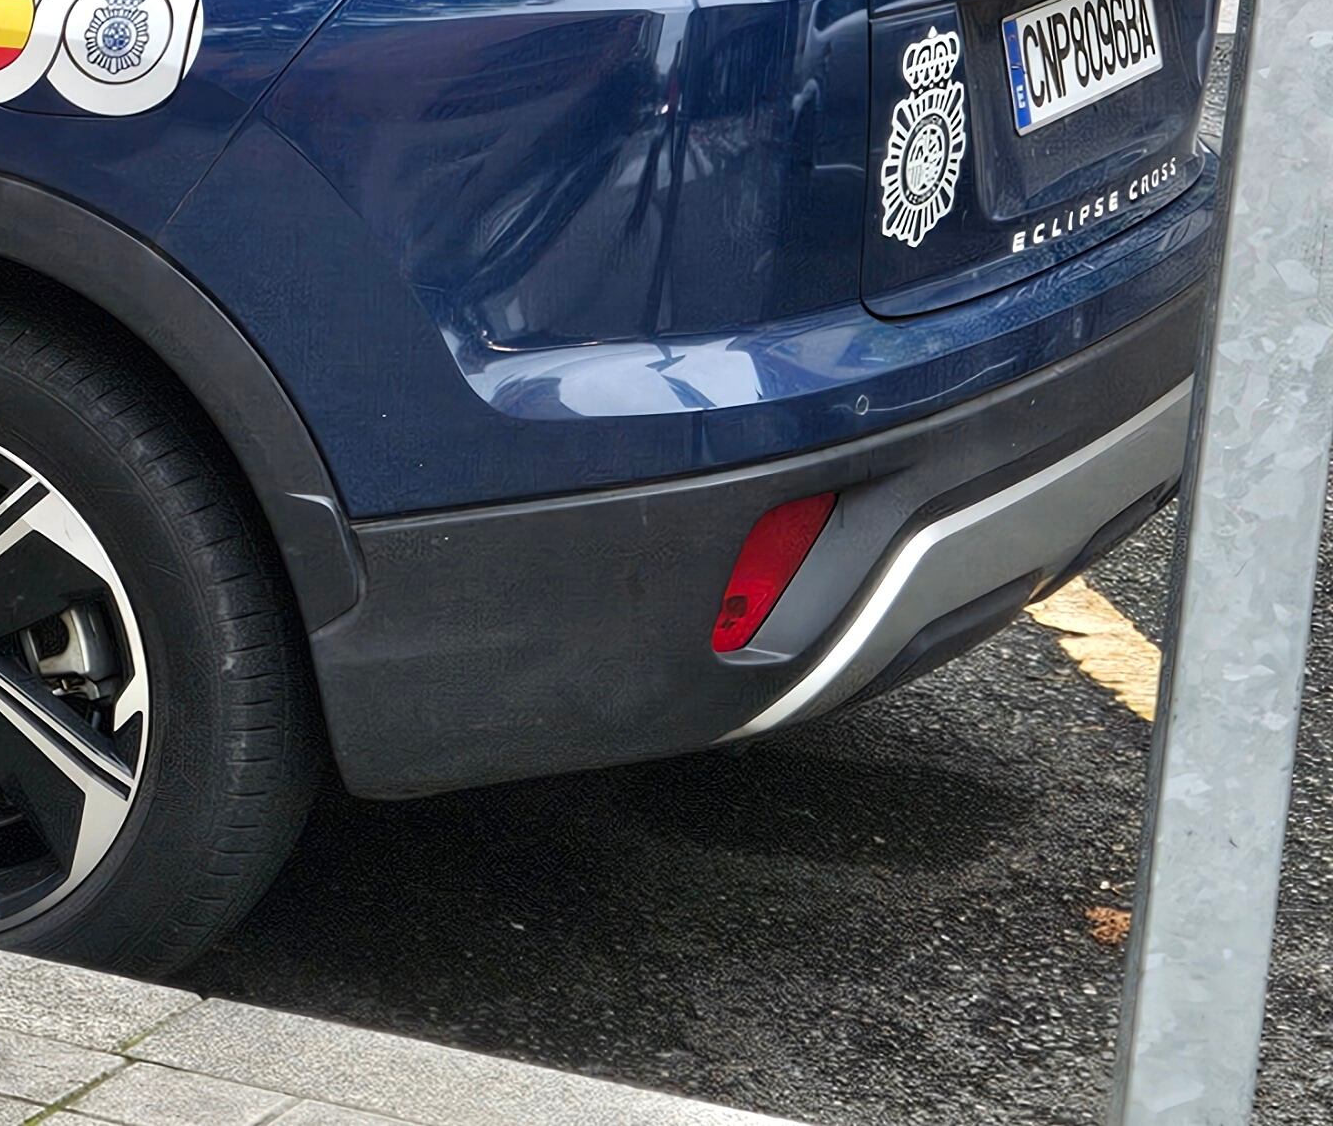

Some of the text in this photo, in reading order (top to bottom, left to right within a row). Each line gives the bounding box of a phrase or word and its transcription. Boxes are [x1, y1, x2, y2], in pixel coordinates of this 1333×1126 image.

[1016, 85, 1026, 109] E
[1012, 157, 1176, 253] ECLIPSE CROSS
